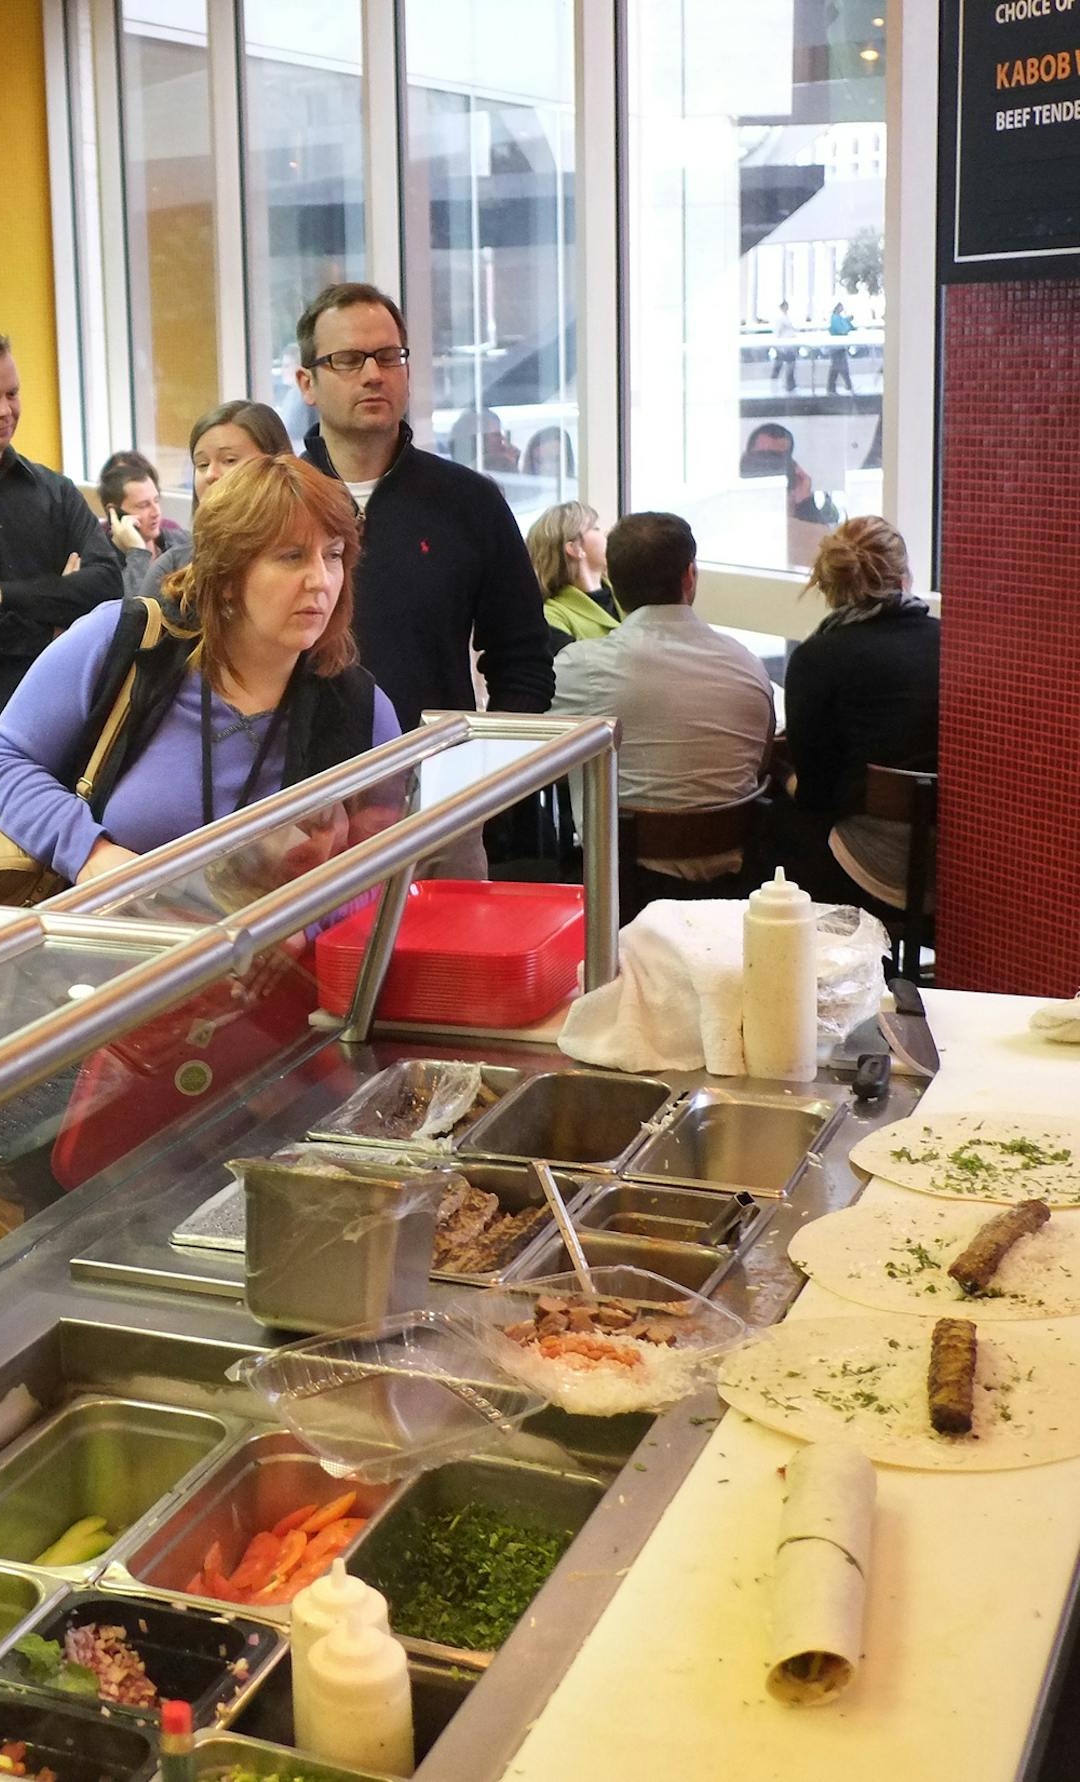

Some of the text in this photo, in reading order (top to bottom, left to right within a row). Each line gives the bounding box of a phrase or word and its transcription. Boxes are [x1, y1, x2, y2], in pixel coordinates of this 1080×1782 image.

[995, 0, 1051, 24] CHOICE
[996, 51, 1071, 90] KABOB
[995, 107, 1031, 131] BEEF
